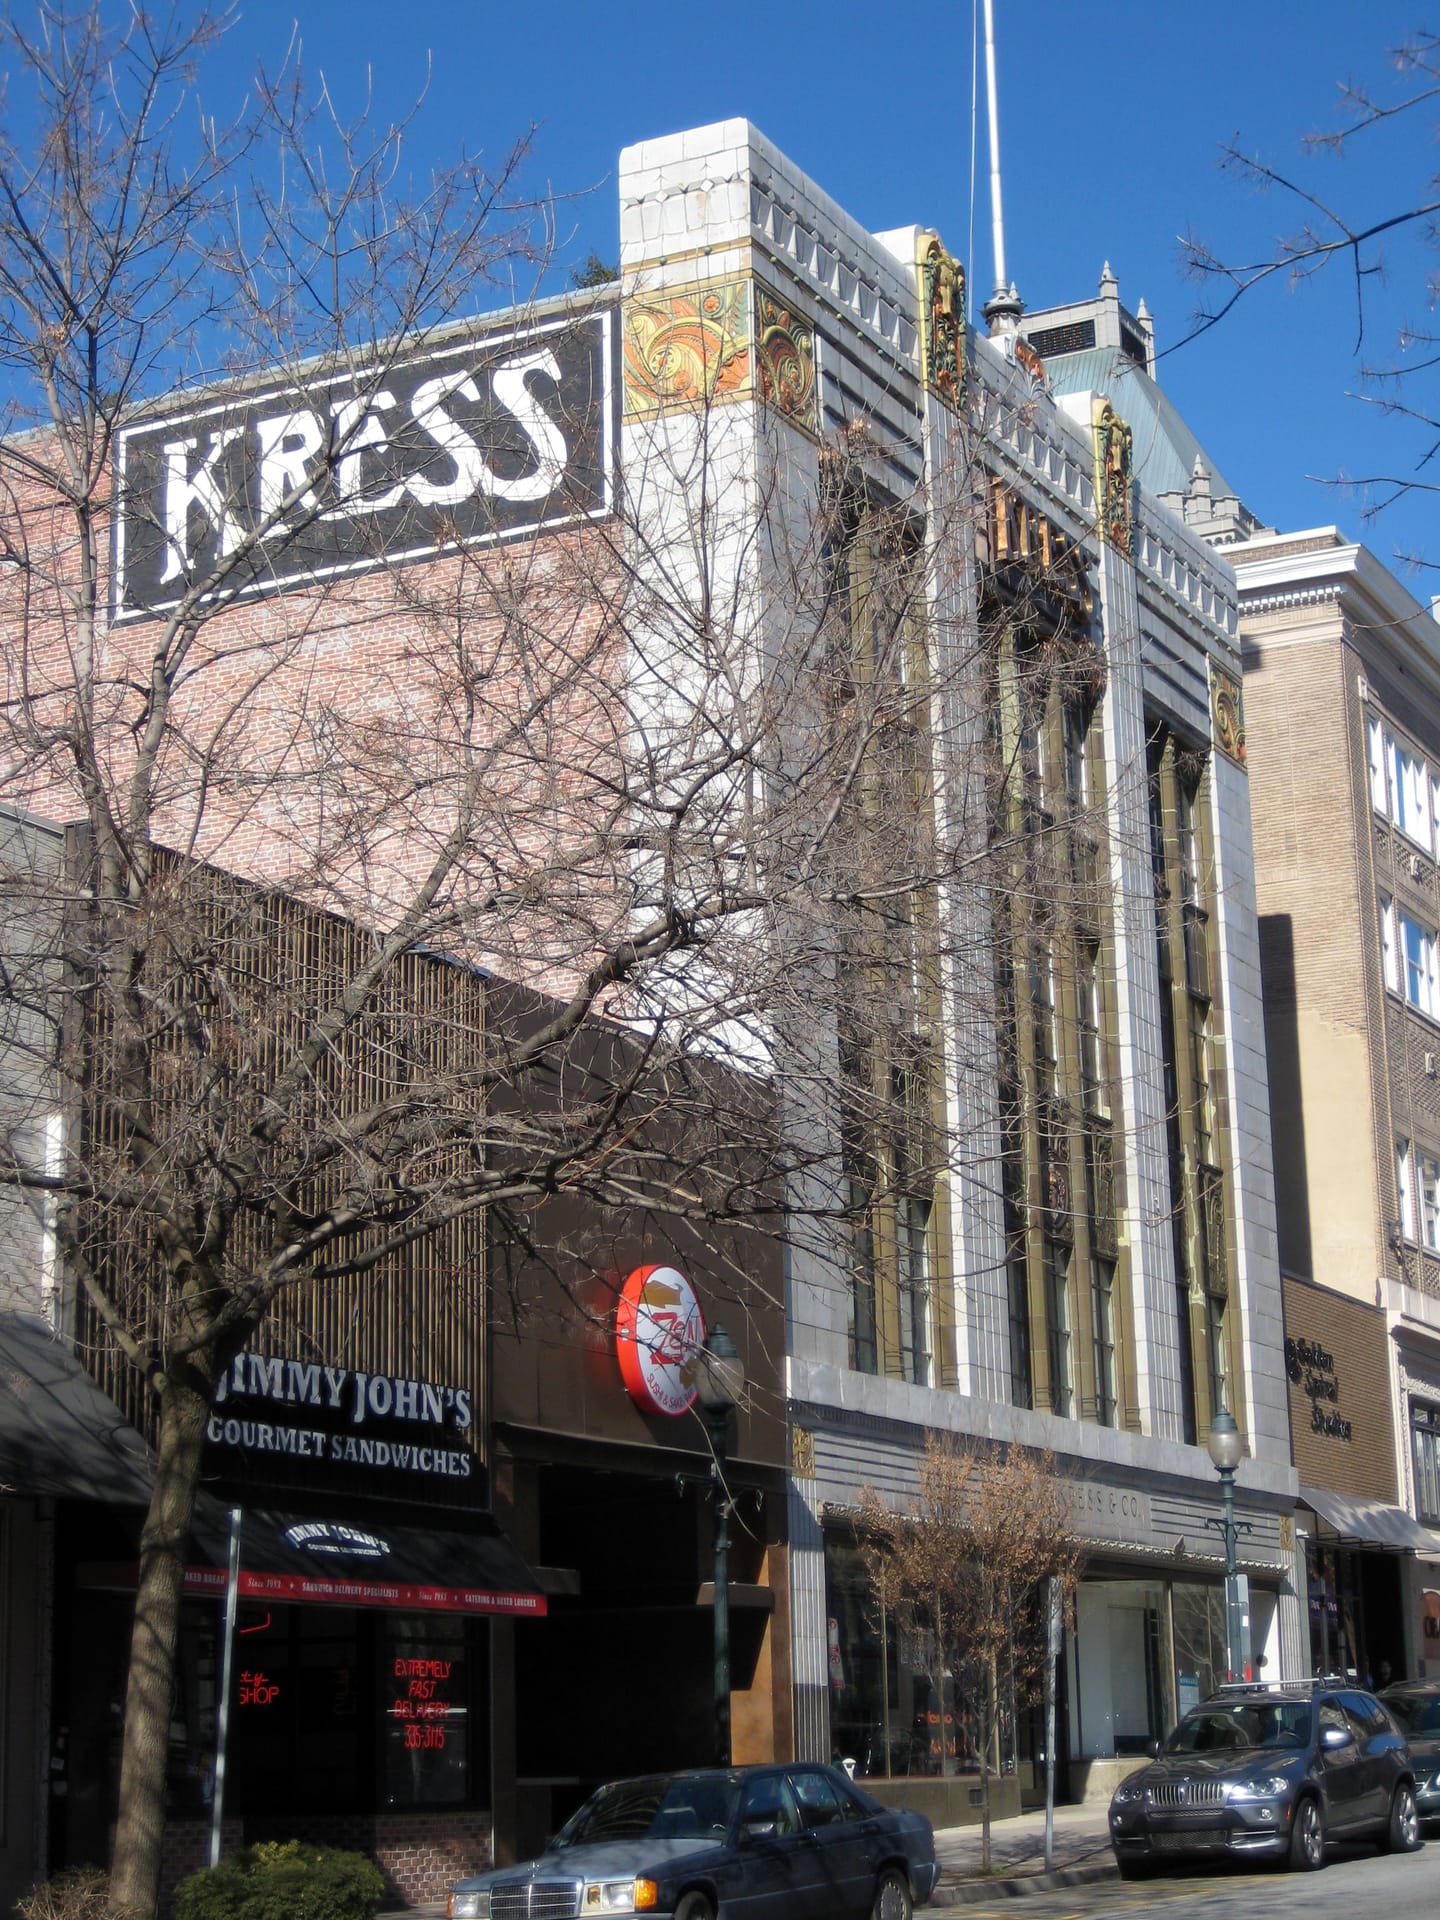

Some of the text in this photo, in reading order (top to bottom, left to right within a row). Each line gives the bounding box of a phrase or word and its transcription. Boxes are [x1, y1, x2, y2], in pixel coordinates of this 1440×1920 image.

[159, 347, 567, 585] KRESS
[215, 1352, 471, 1429] JIMMY JOHN'S
[207, 1415, 471, 1477] GOURMET SANDWICHES
[185, 1570, 201, 1583] AKED
[393, 1658, 453, 1679] EXTREMELY
[408, 1679, 438, 1699] FAST
[393, 1699, 451, 1720] DELIVERY
